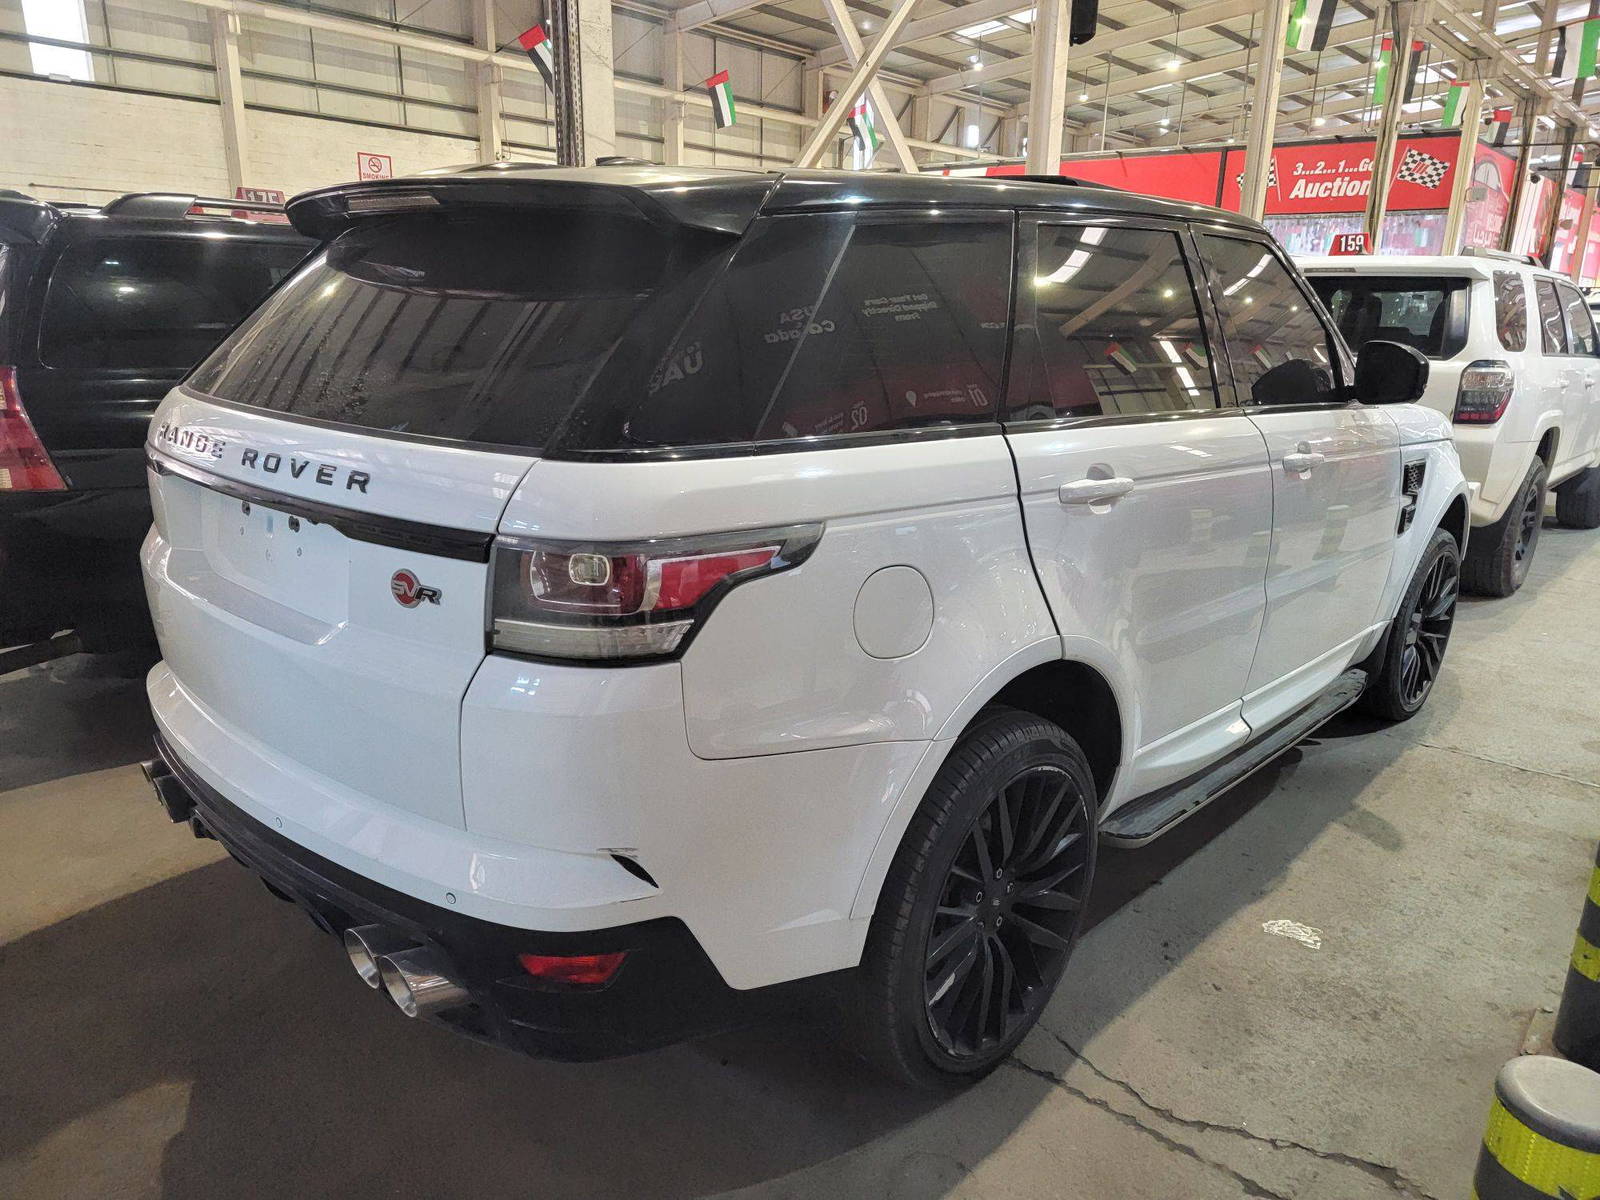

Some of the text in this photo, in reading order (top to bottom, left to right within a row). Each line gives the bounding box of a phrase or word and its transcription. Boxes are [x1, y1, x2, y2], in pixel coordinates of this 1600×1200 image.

[1288, 176, 1371, 199] Auction
[1340, 234, 1364, 252] 159
[157, 423, 371, 494] RANGE ROVER
[391, 580, 442, 605] SVR
